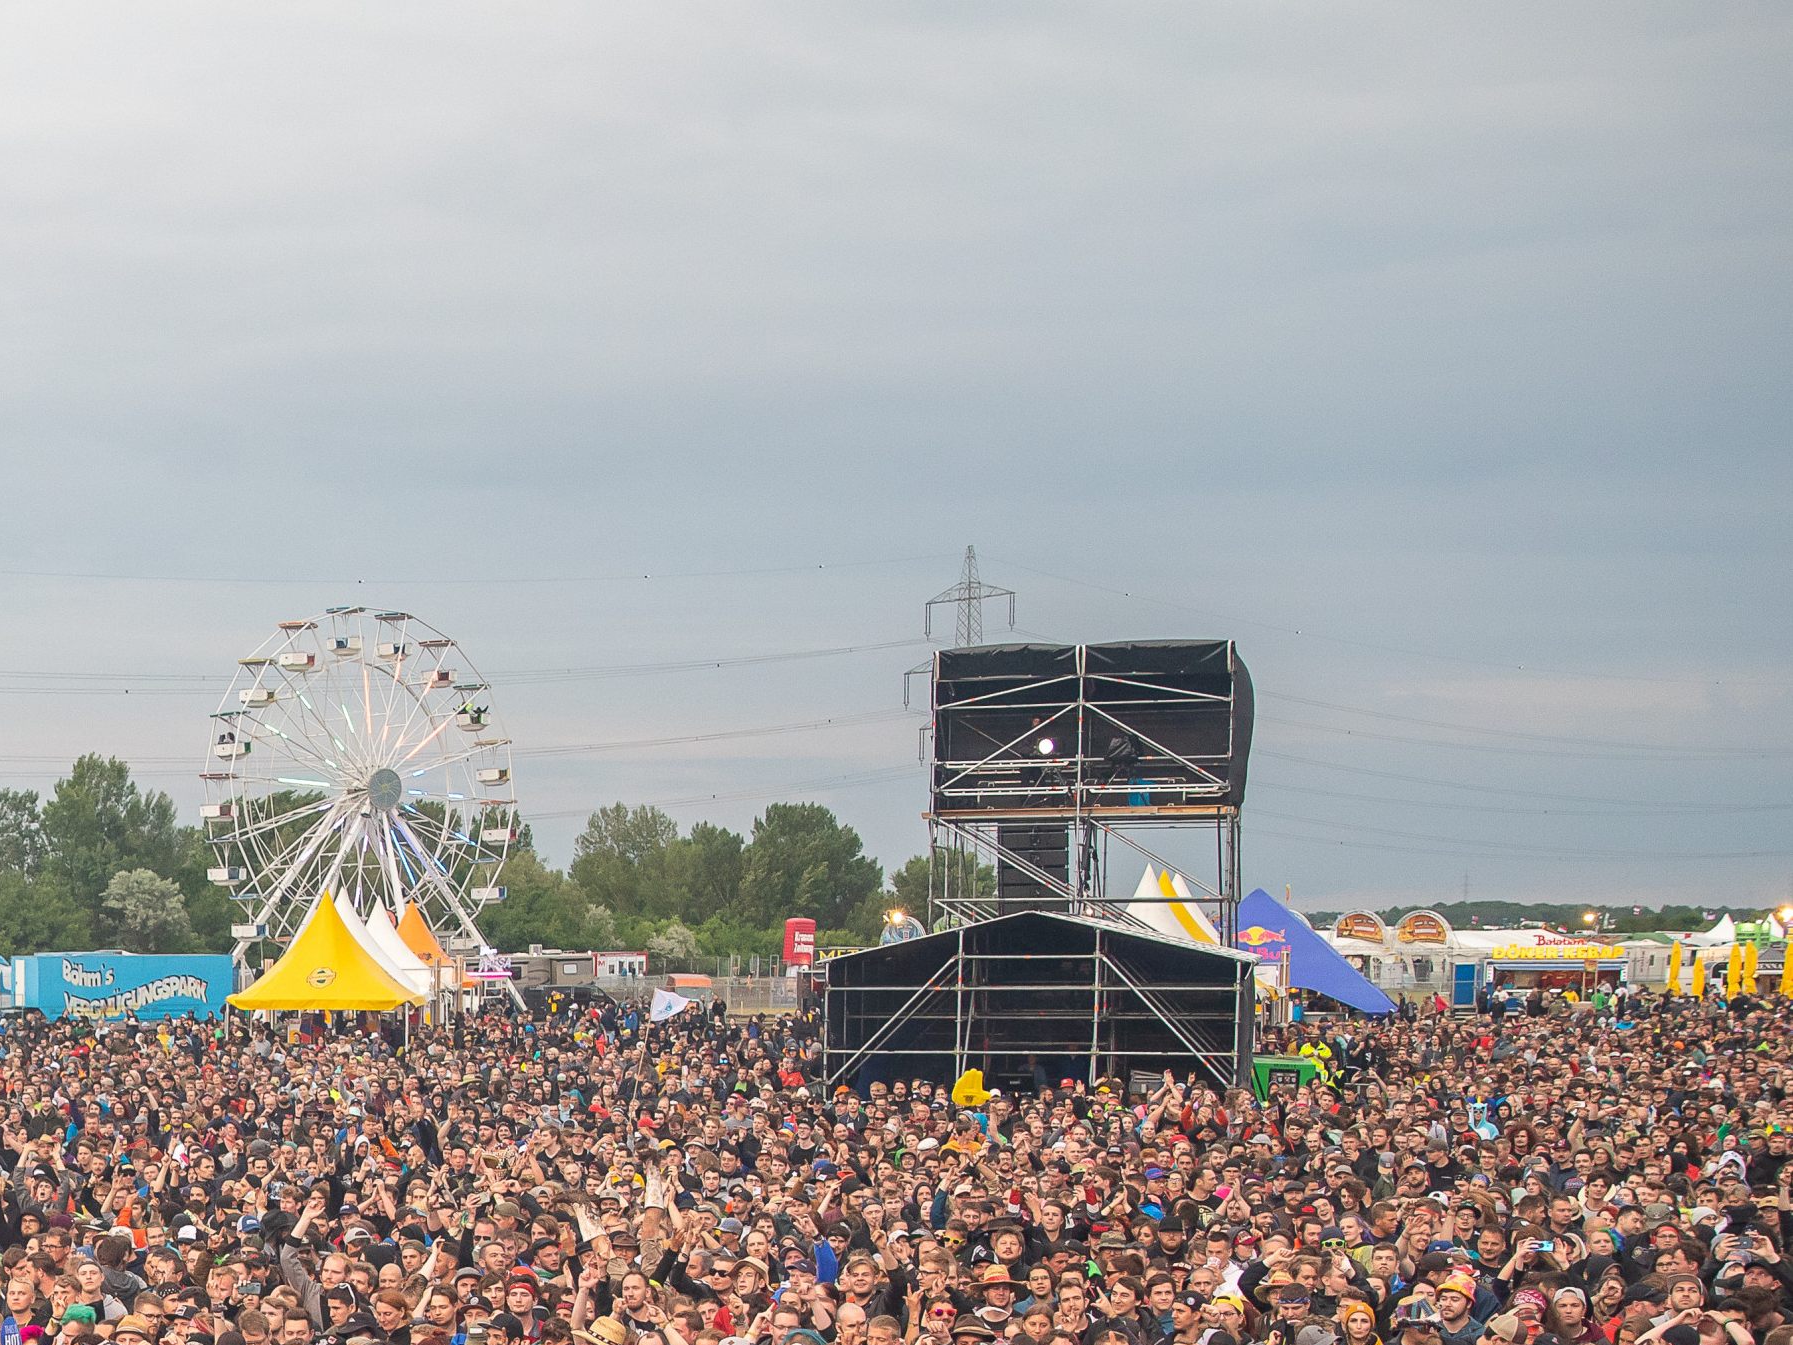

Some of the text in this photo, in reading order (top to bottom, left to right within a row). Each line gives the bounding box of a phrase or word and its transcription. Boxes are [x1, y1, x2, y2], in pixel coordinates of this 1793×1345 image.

[794, 931, 814, 942] Kronen
[1492, 944, 1625, 959] DÖNER KEBAP
[64, 975, 208, 1019] VERGNÜGUNGSPARK
